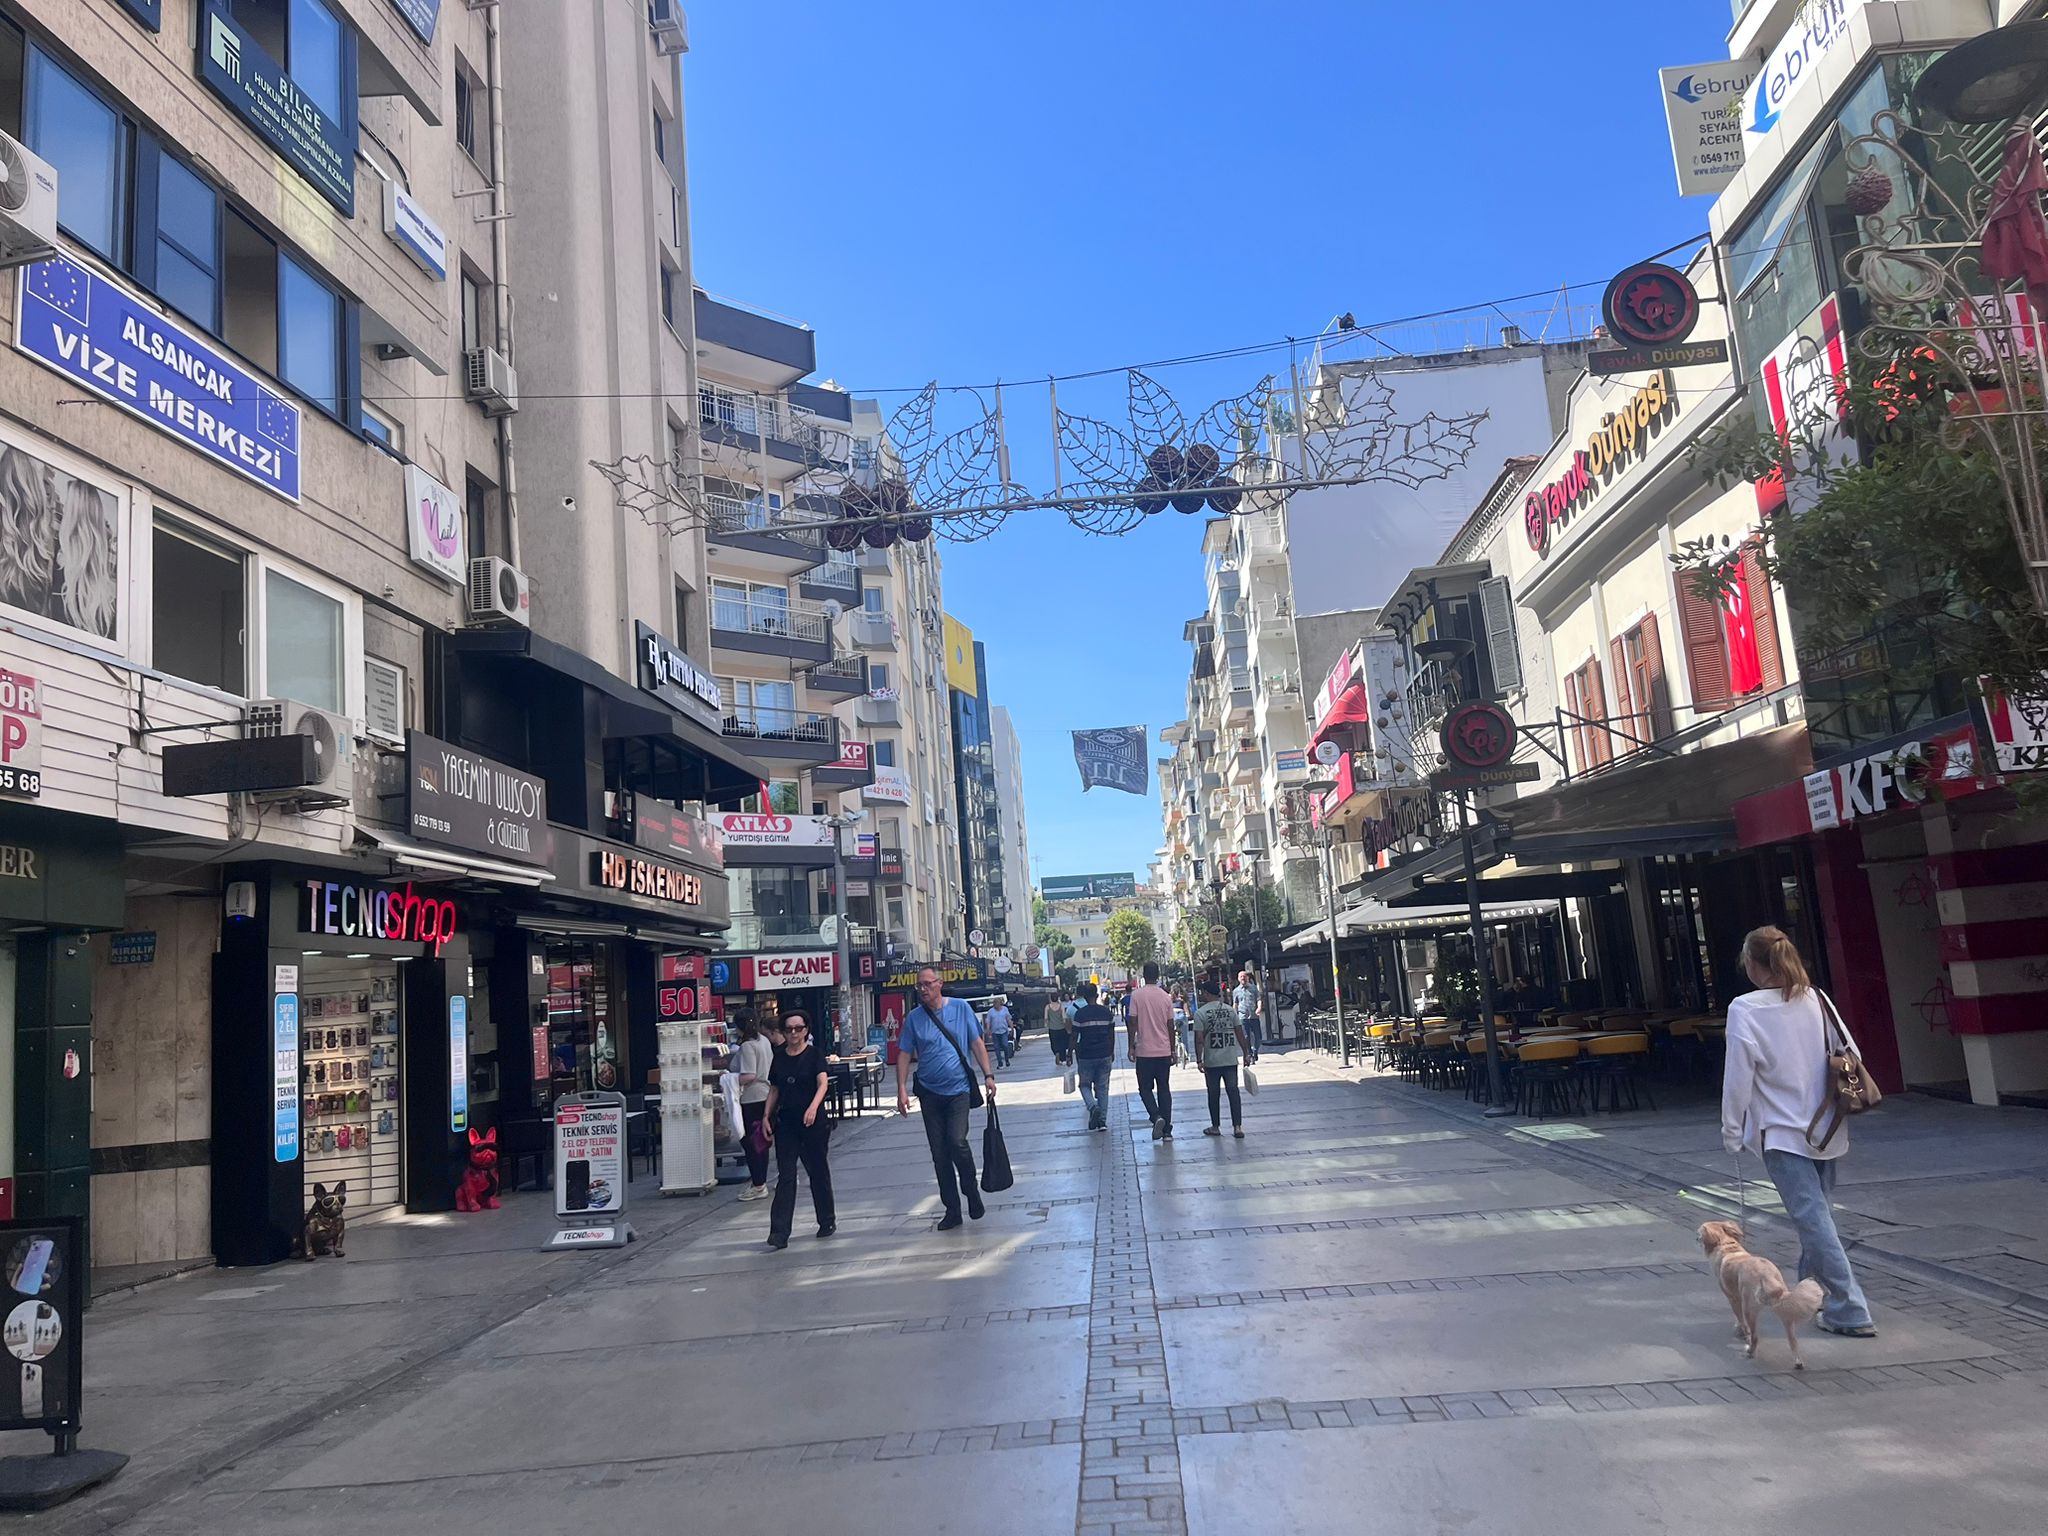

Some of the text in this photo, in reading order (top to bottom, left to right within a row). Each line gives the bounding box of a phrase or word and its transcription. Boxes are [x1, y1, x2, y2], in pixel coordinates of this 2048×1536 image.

[279, 76, 321, 133] BİLGE
[1701, 107, 1733, 121] TURİ
[254, 71, 343, 169] HUKUK & DANIŞMANLIK
[257, 94, 281, 124] Damla
[327, 165, 351, 194] AZMAN
[1700, 150, 1740, 164] 0549 717
[122, 315, 233, 406] ALSANCAK
[1652, 346, 1719, 364] Dünyası
[52, 322, 281, 481] VİZE MERKEZİ
[1541, 368, 1668, 526] Tavuk Dünyası
[19, 771, 40, 793] 68
[440, 751, 542, 821] YASEMİN ULUSOY
[1837, 741, 1927, 821] KFC
[729, 816, 788, 832] ATLAS
[497, 817, 532, 854] GÜZELLİK
[728, 832, 790, 843] YURTDIŞI EĞİTİM
[601, 851, 628, 889] HD
[306, 880, 457, 958] TECNOshop
[757, 956, 831, 978] ECZANE
[781, 976, 810, 986] ÇAĞDAŞ
[883, 969, 918, 988] ZMİ
[660, 986, 695, 1016] 50
[276, 1084, 297, 1098] TEKNİK
[276, 1097, 297, 1112] SERVİS
[562, 1123, 618, 1138] TEKNİK SERVİS
[590, 1146, 613, 1158] SATIM
